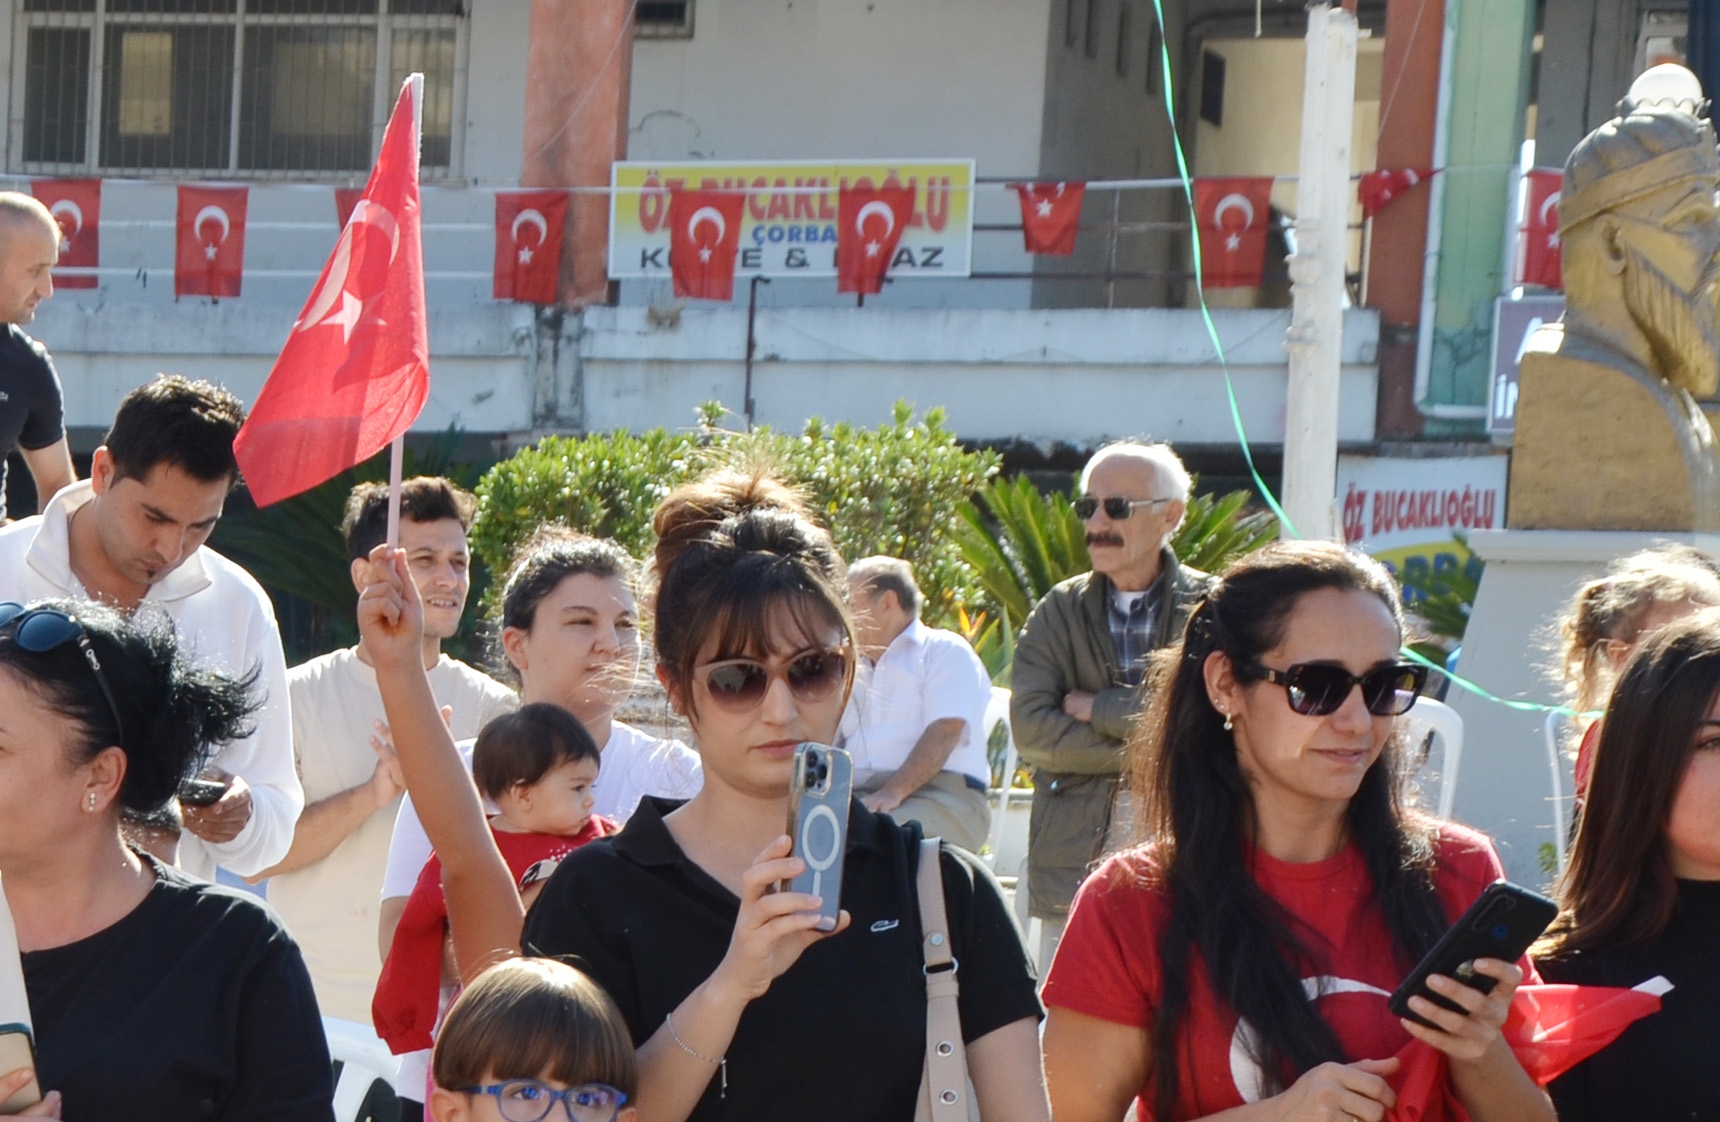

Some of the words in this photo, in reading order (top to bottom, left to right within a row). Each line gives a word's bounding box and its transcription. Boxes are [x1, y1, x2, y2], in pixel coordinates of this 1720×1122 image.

[751, 223, 838, 247] ÇORBA
[1342, 481, 1367, 546] ÖZ
[1372, 483, 1497, 536] BUCAKLIOĞLU
